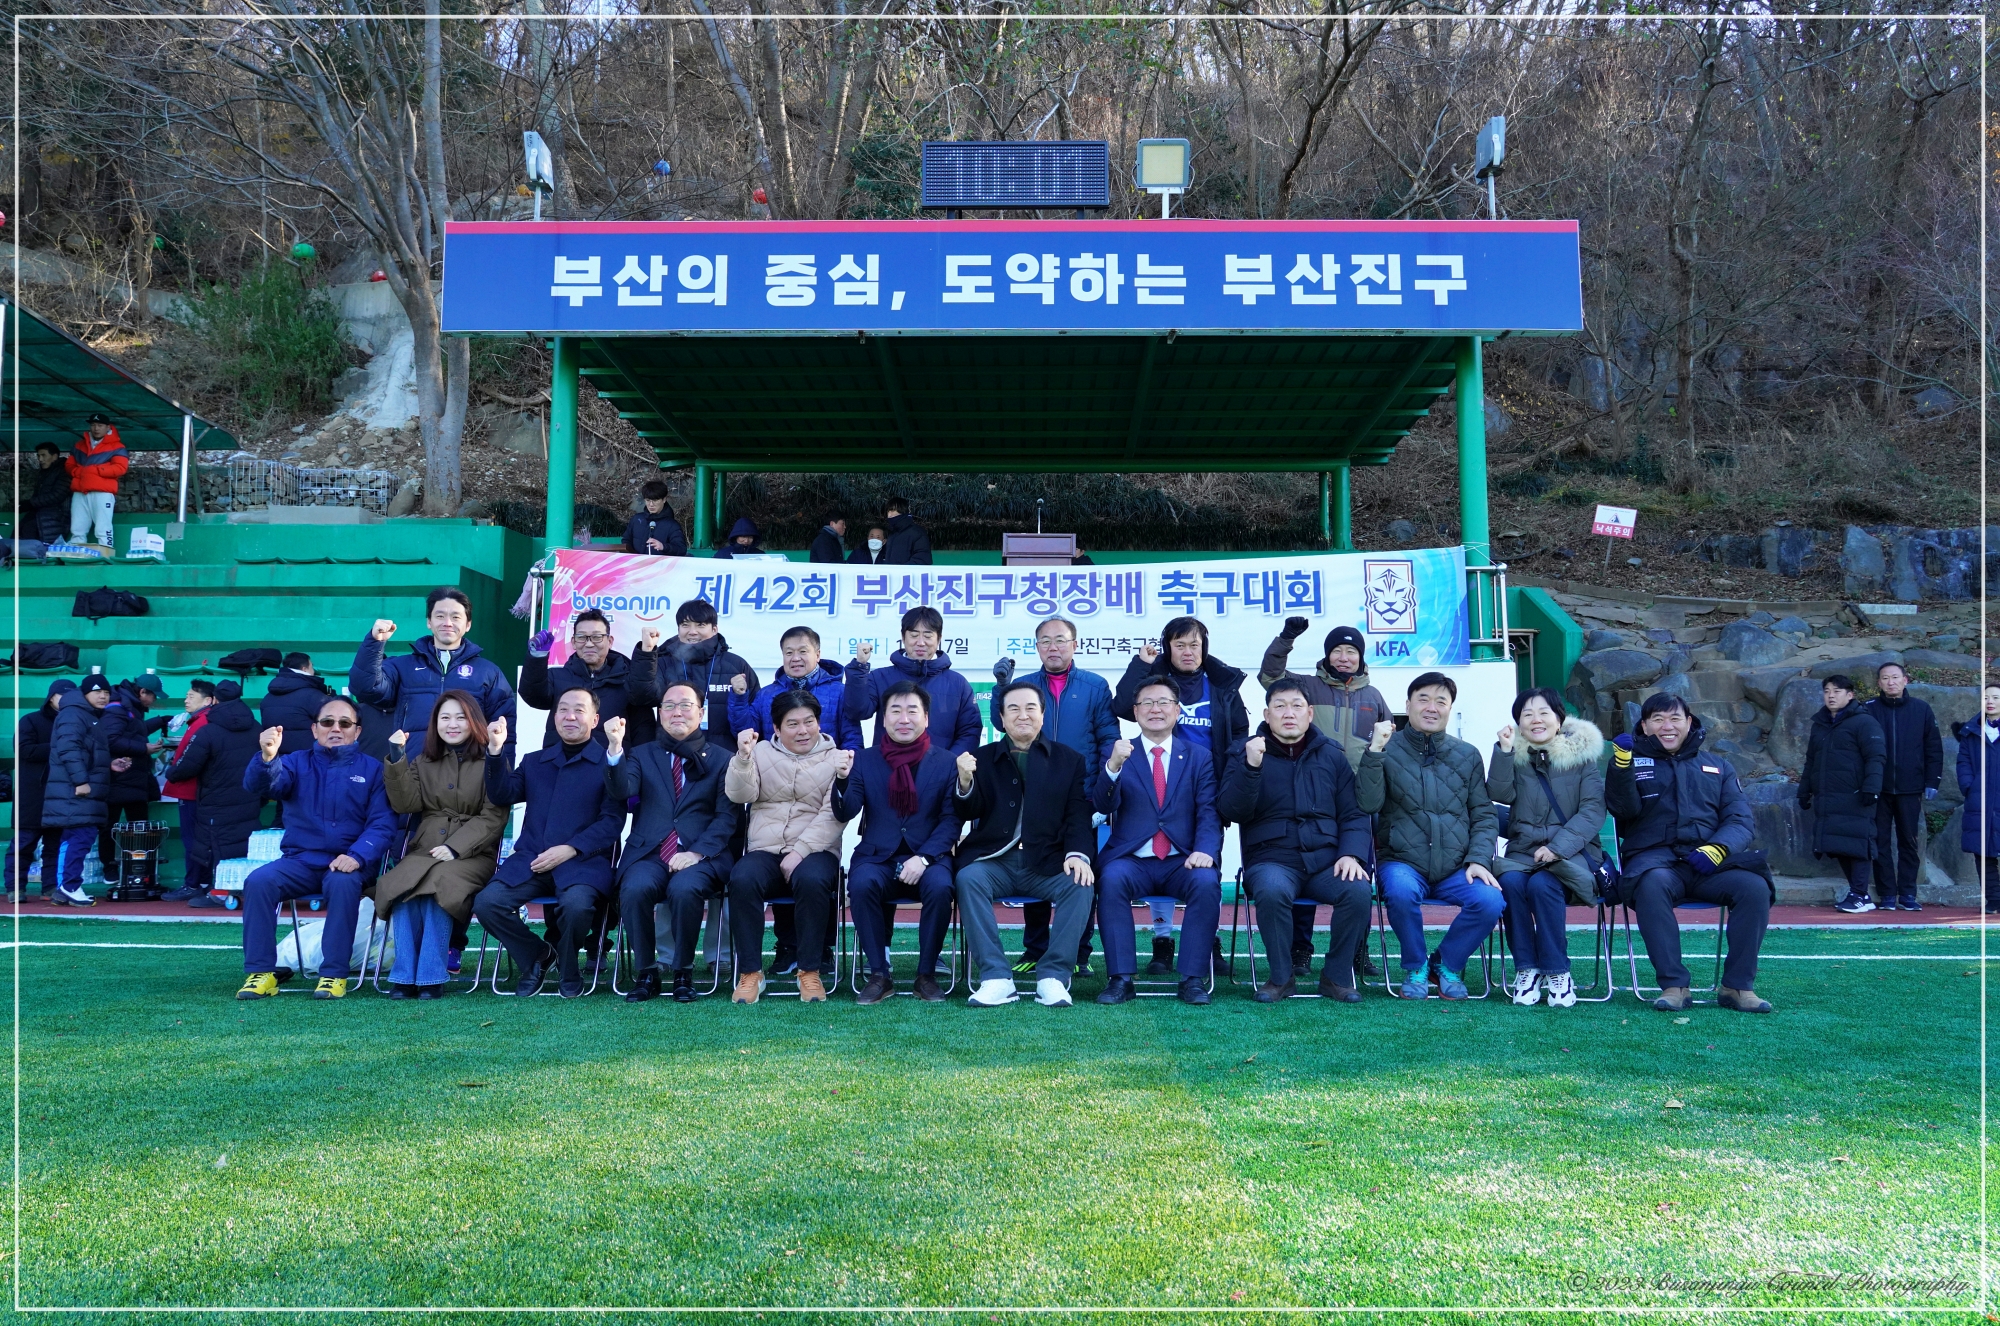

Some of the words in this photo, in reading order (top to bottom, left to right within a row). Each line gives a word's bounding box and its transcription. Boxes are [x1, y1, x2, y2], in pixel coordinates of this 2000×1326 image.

[551, 254, 728, 307] 부산의
[765, 254, 906, 311] 중심,
[942, 253, 1187, 306] 도약하는
[1222, 254, 1468, 306] 부산진구
[1596, 523, 1631, 537] 낙석주의
[572, 591, 671, 616] busanjin
[852, 571, 1143, 616] 부산진구청장배
[1157, 569, 1322, 614] 축구대회
[1375, 640, 1411, 657] KFA
